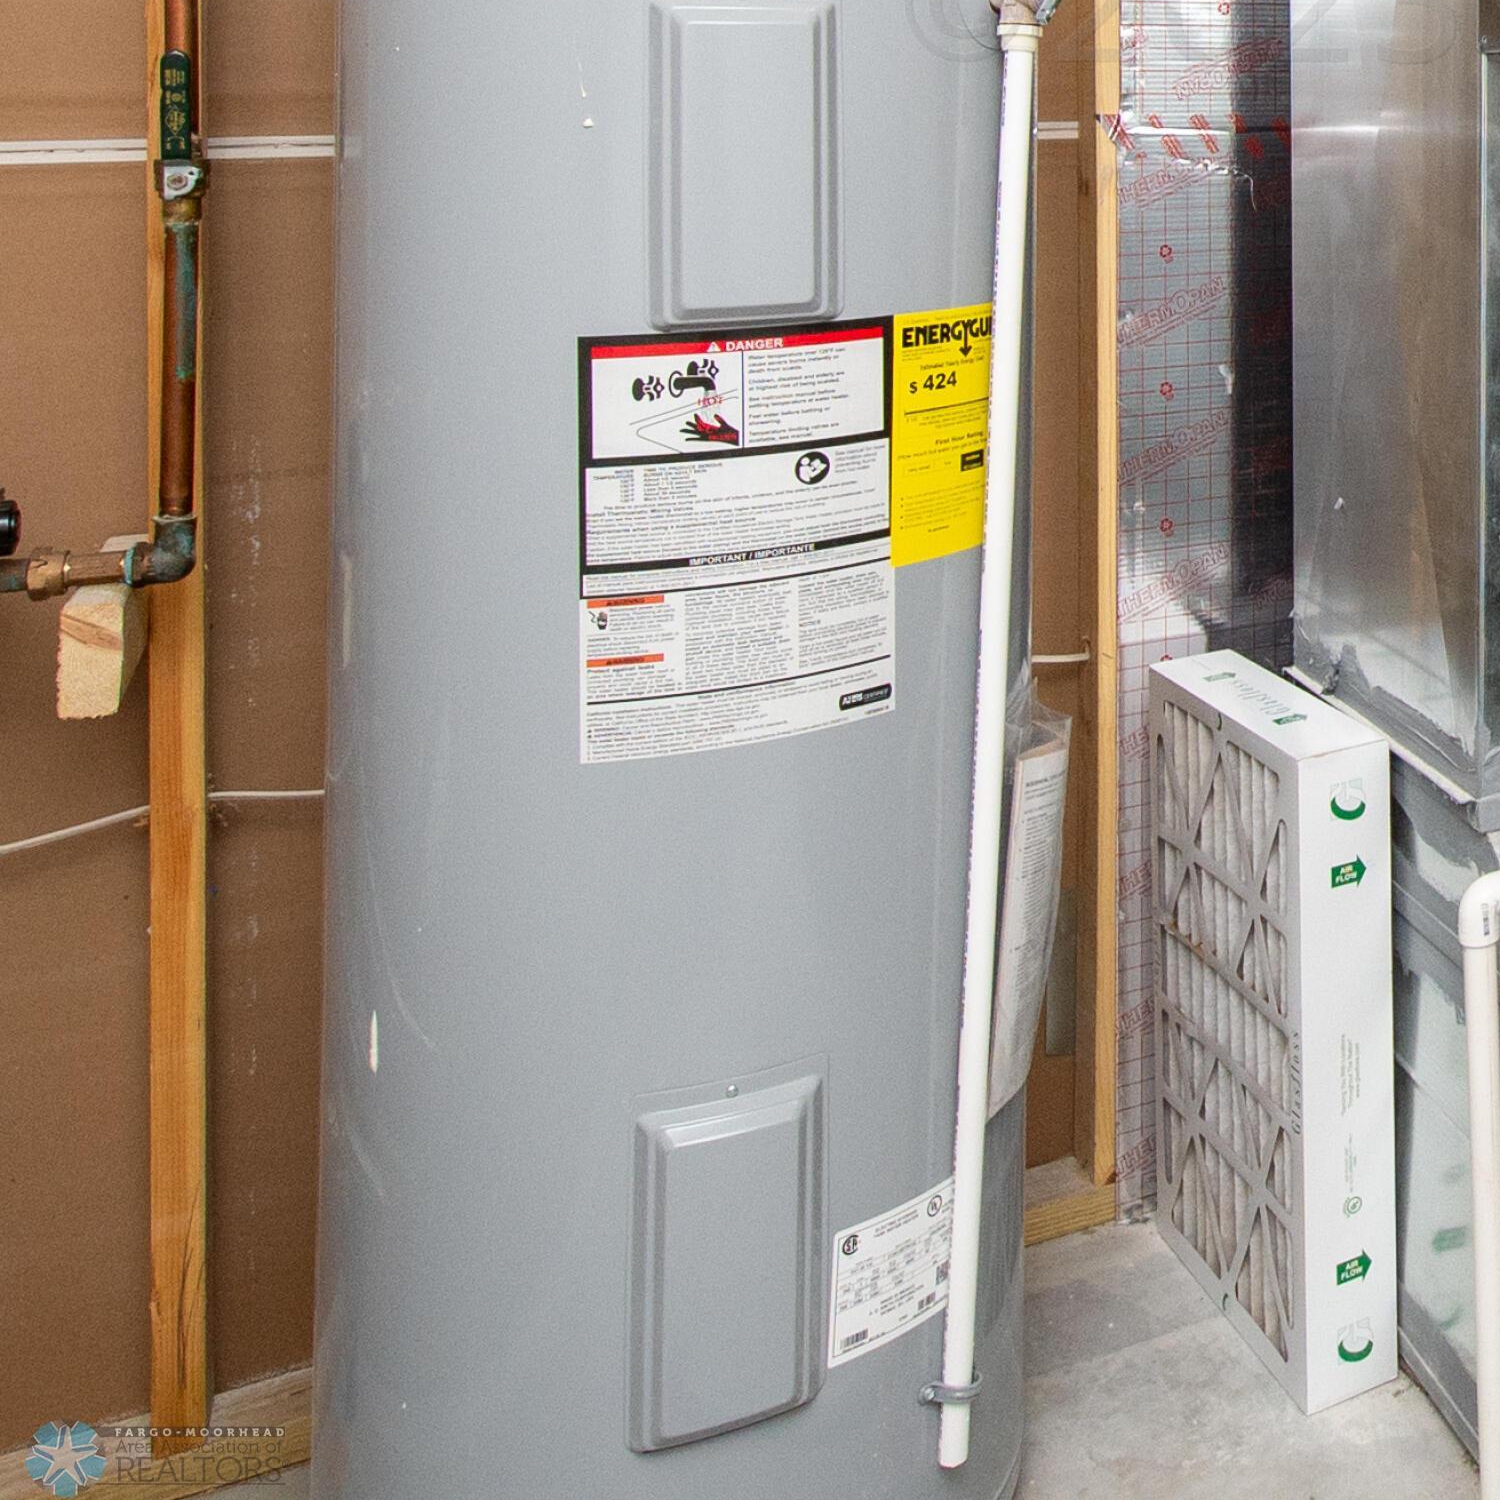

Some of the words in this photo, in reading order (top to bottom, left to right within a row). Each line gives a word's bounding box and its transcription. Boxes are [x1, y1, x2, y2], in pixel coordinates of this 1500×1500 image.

[725, 337, 784, 352] DANGER
[923, 370, 957, 391] 424
[1335, 870, 1357, 884] FLOW
[1340, 864, 1353, 876] AIR
[1289, 1031, 1301, 1135] Glasfloss
[1345, 1259, 1359, 1270] AIR
[1341, 1266, 1363, 1281] FLOW
